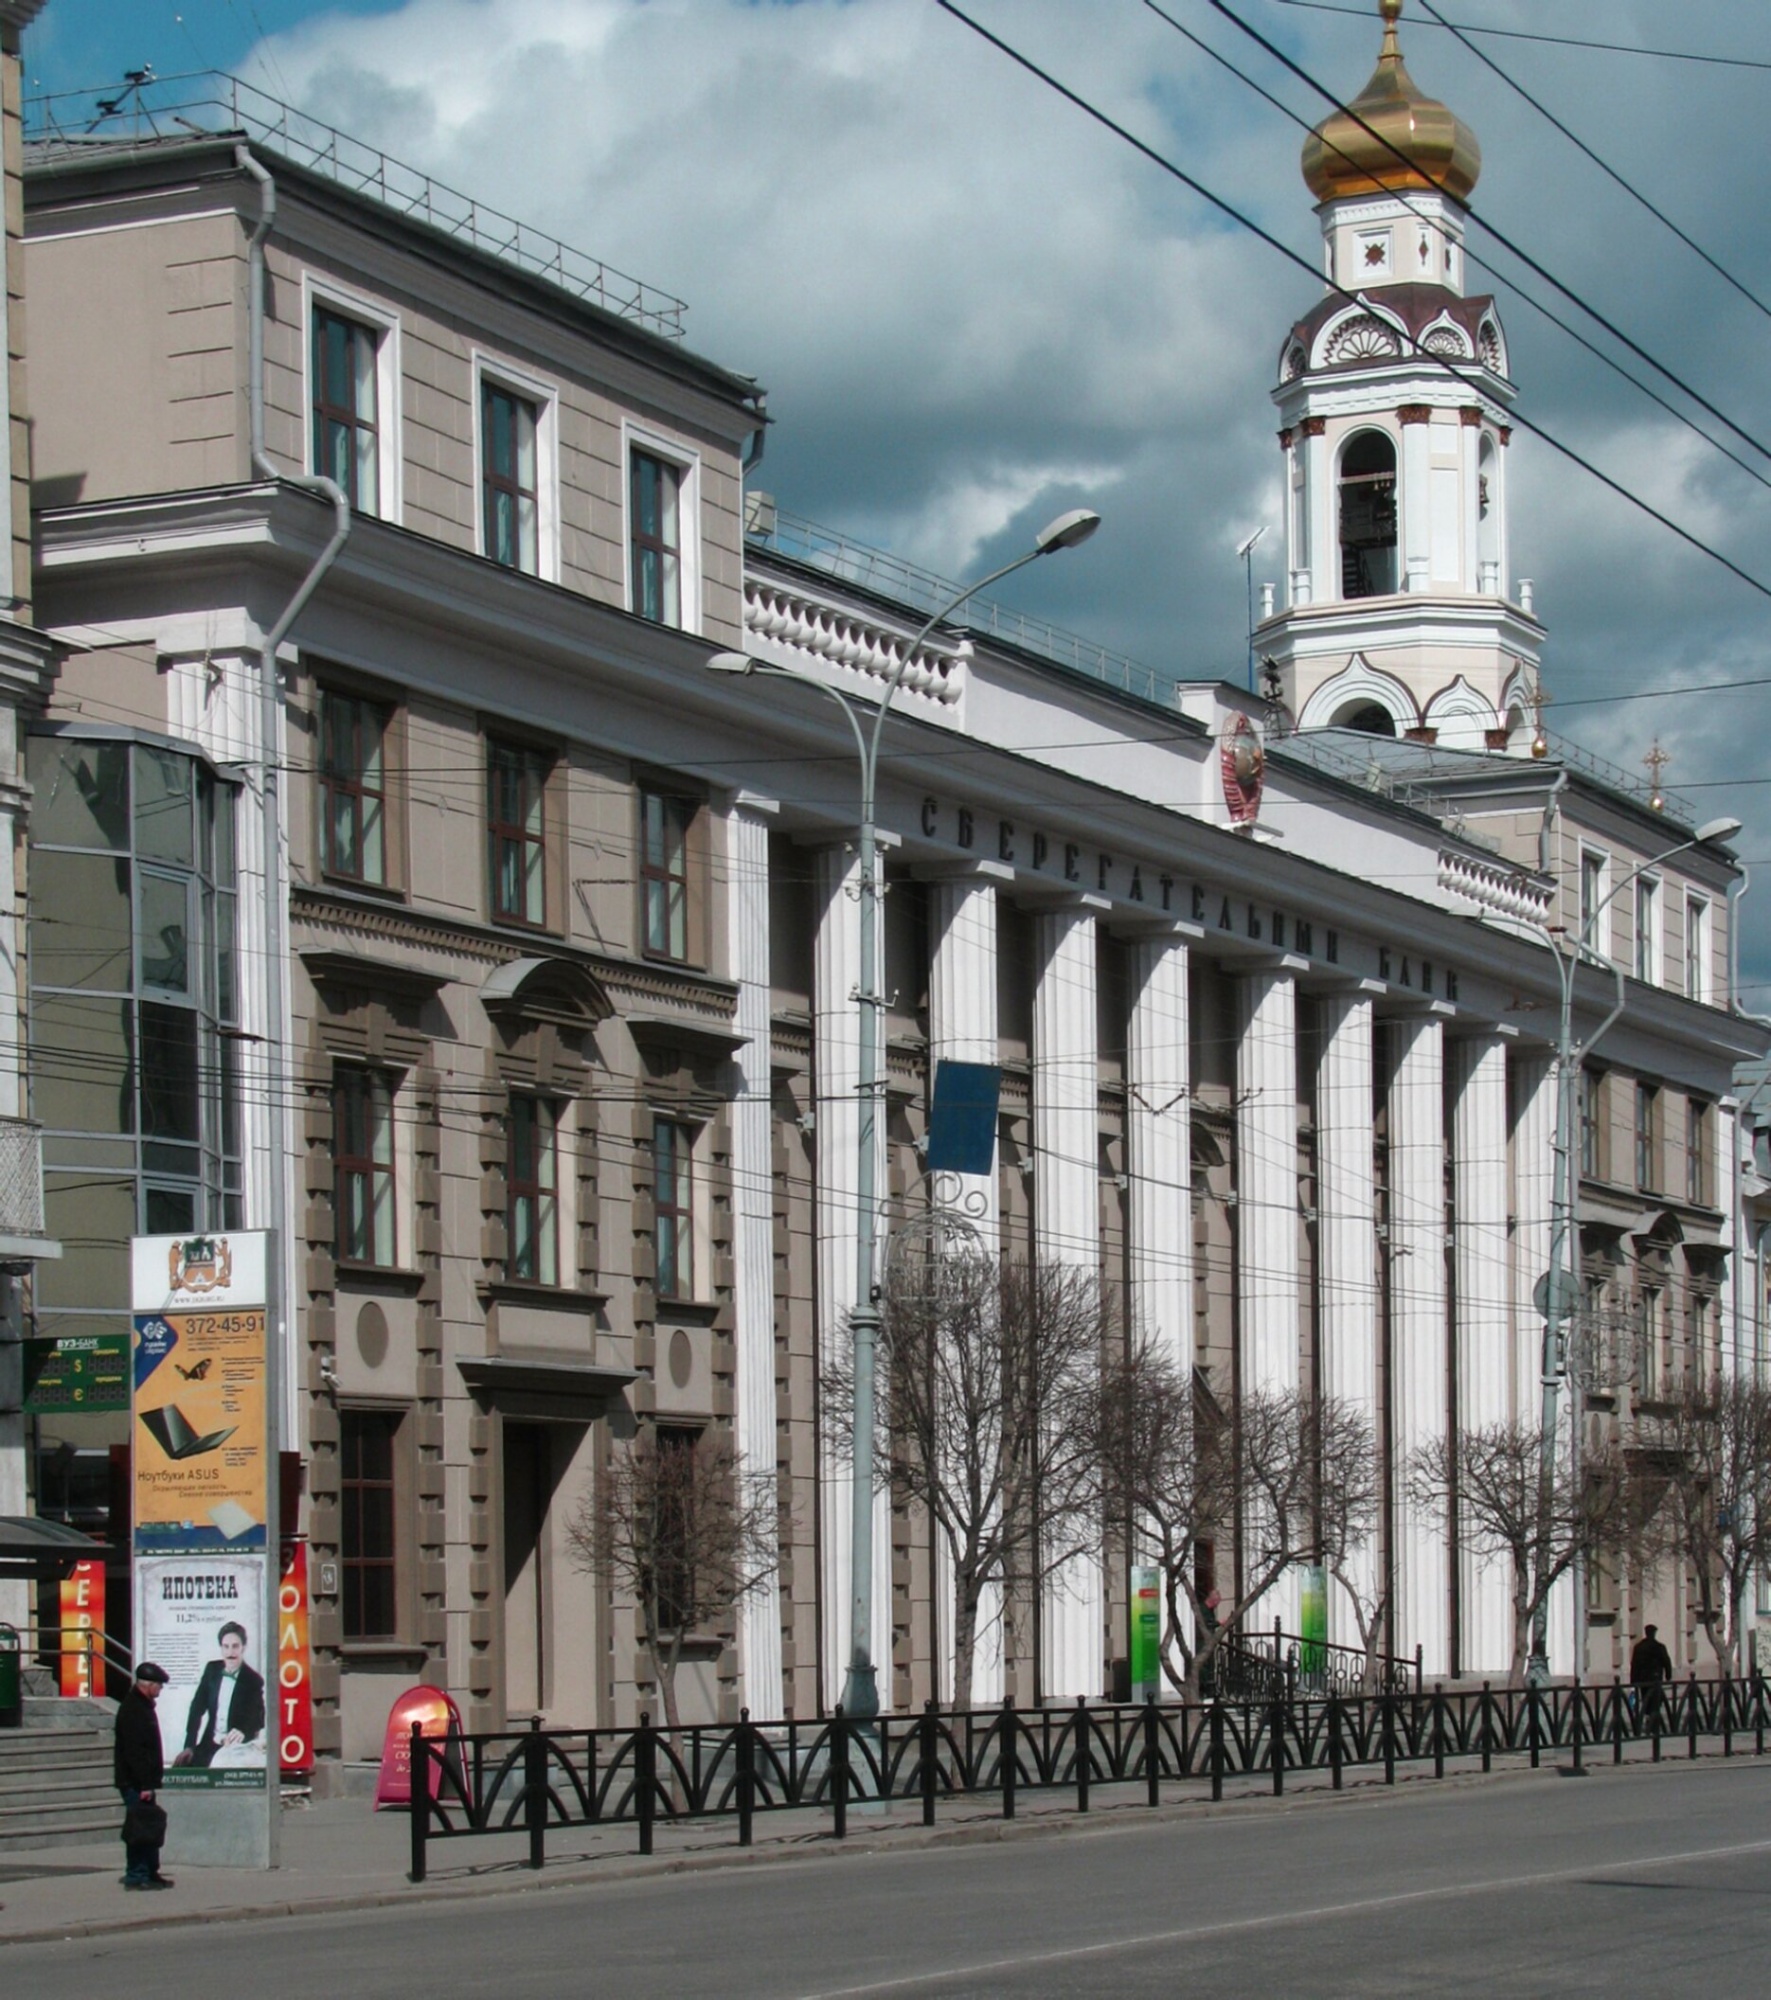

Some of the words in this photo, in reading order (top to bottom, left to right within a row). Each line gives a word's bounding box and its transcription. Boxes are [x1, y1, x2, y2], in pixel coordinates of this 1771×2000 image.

[1378, 946, 1458, 1001] БАНК
[56, 1338, 99, 1349] ВУЗ-БАНК
[137, 1470, 185, 1483] Ноутбуки
[187, 1468, 220, 1480] ASUS
[162, 1575, 239, 1600] ИПОТЕКА
